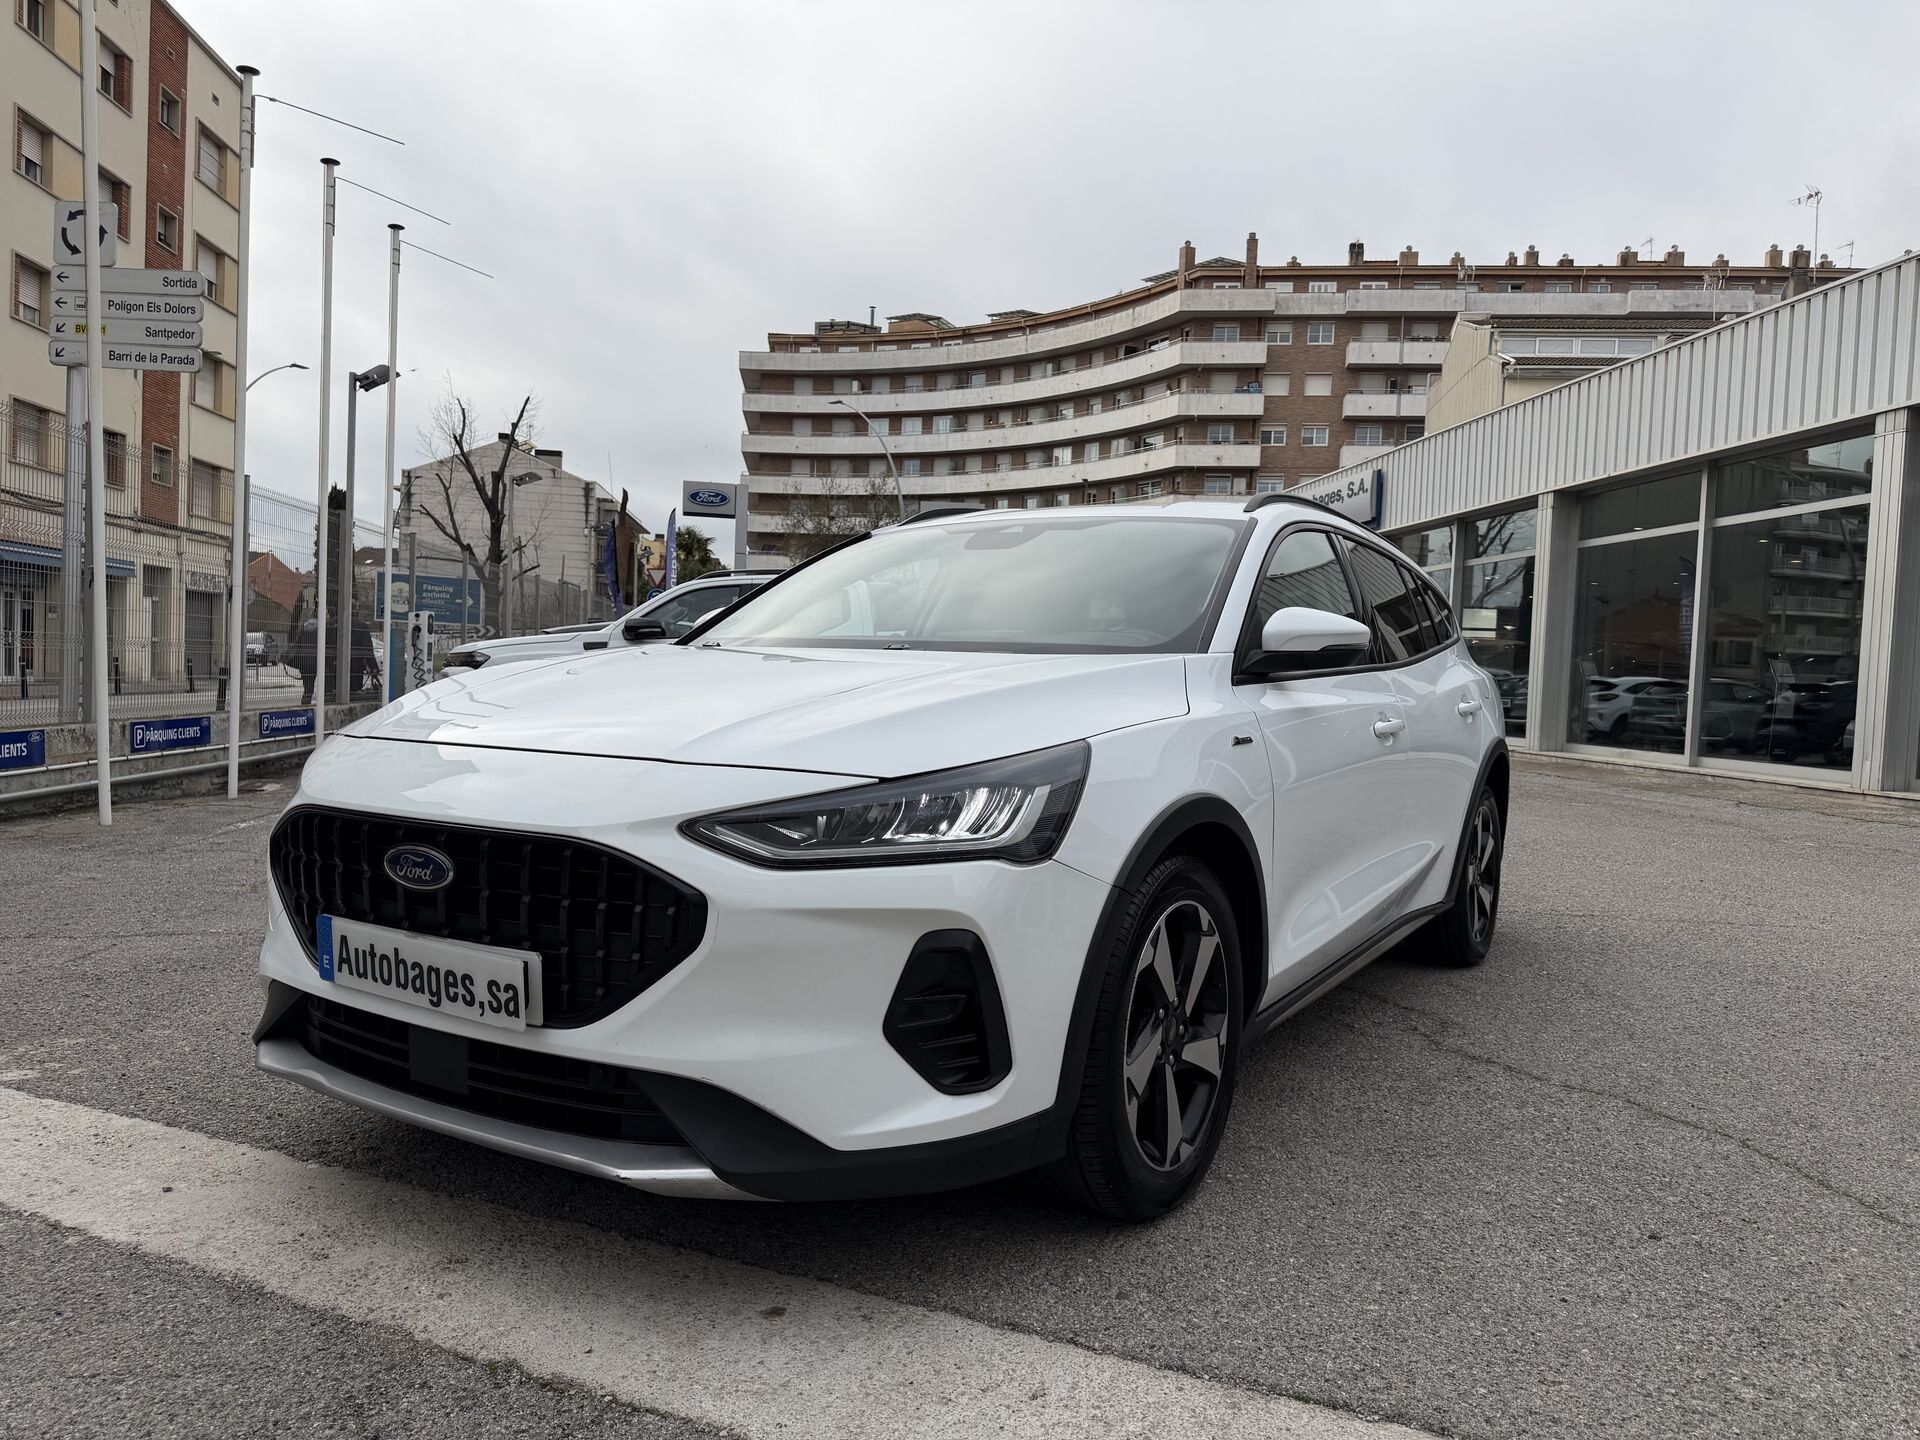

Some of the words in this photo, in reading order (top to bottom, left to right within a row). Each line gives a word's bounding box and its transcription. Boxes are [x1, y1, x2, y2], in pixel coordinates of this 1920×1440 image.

[162, 276, 198, 288] Sortida
[108, 299, 144, 314] Polígon
[147, 301, 161, 313] Els
[164, 302, 196, 315] Dolors
[145, 326, 196, 341] Santpedor
[108, 350, 132, 362] Barri
[134, 352, 147, 363] de
[149, 352, 158, 364] la
[160, 353, 195, 366] Parada
[1346, 478, 1369, 499] S.A.
[696, 491, 721, 503] Ford
[136, 729, 143, 745] P
[177, 726, 201, 740] CLIENTS
[396, 854, 434, 881] Ford
[323, 954, 331, 969] E
[336, 934, 521, 1019] Autobages,sa
